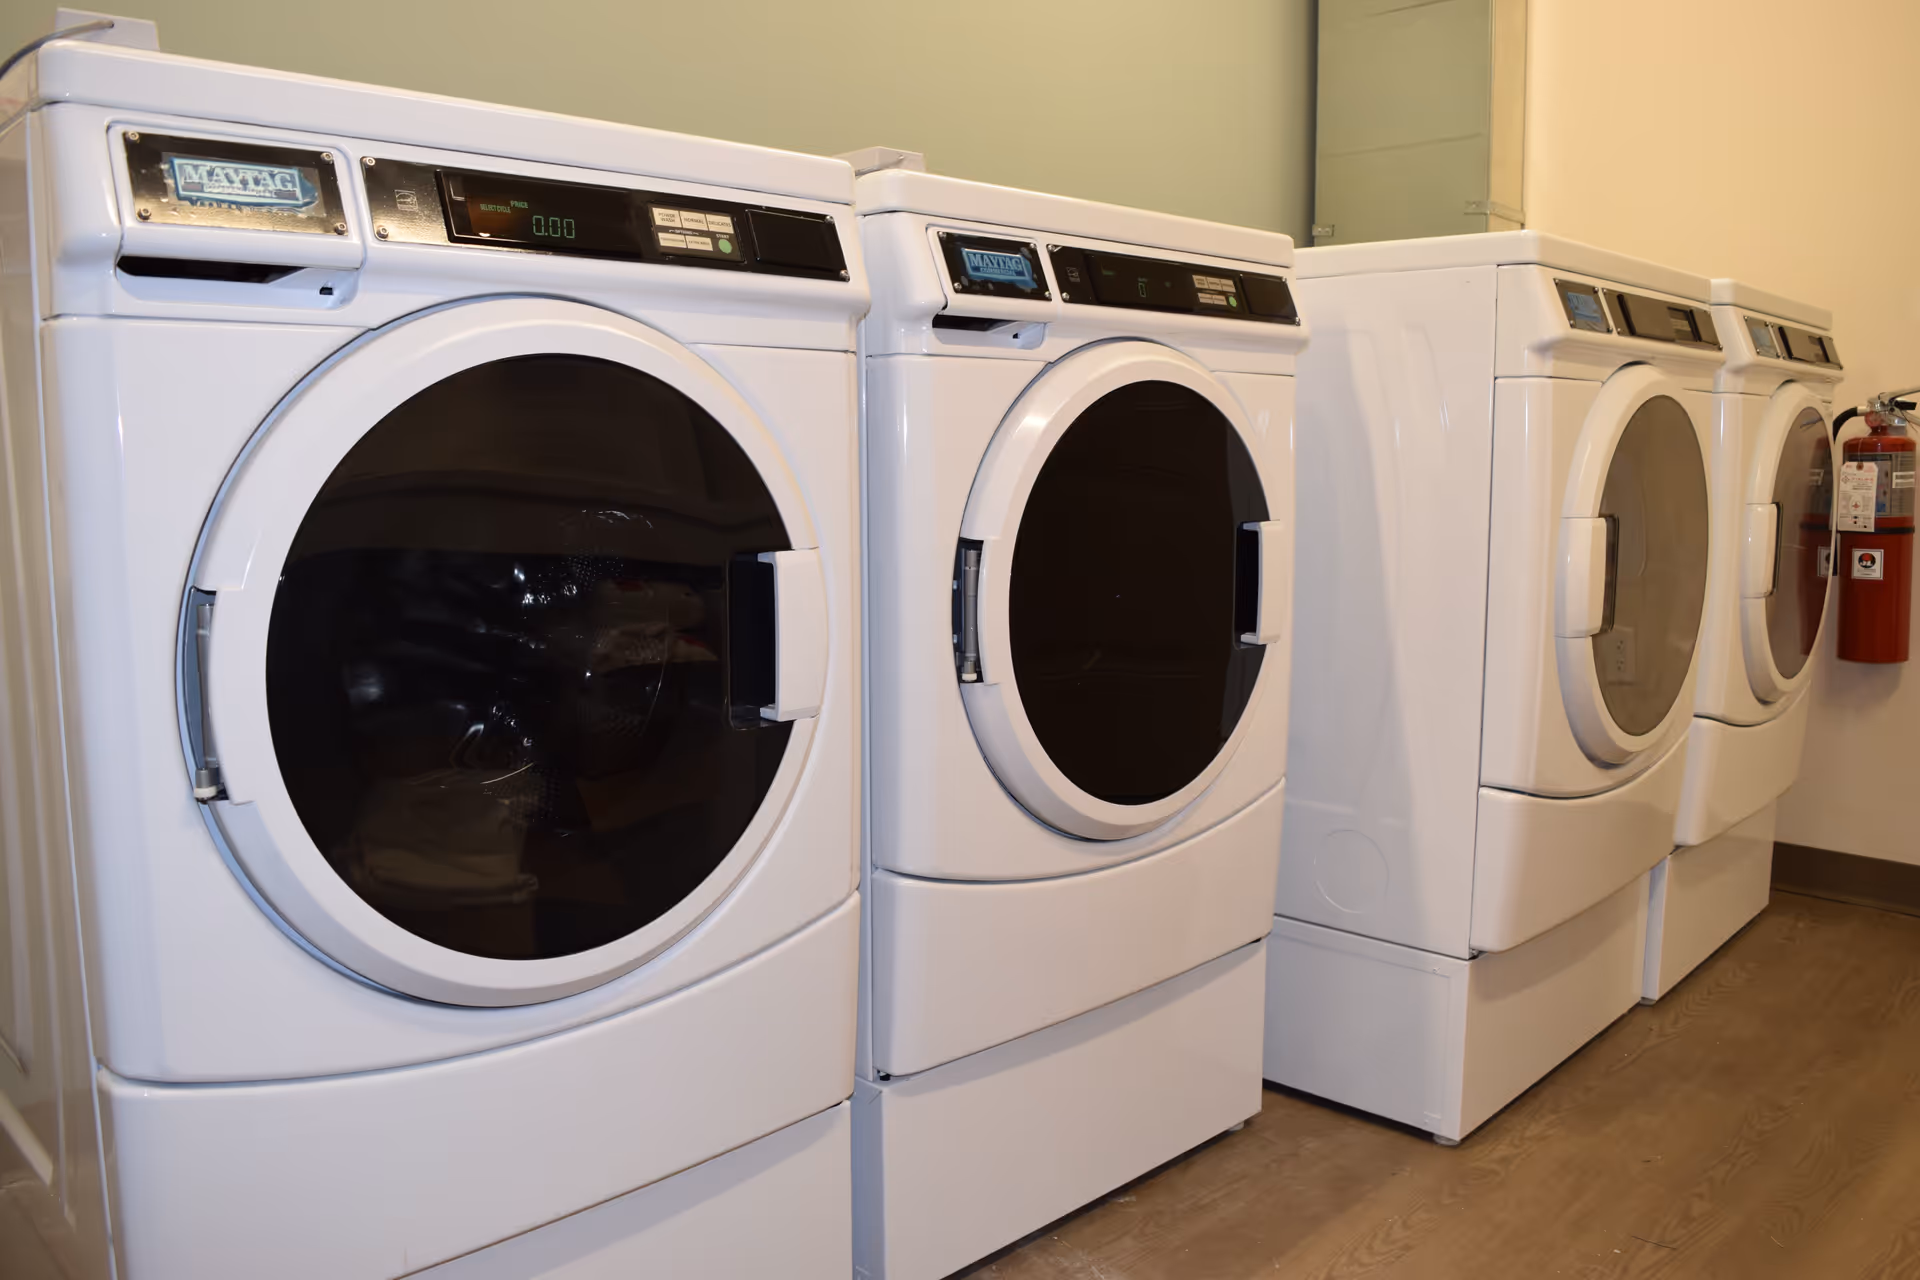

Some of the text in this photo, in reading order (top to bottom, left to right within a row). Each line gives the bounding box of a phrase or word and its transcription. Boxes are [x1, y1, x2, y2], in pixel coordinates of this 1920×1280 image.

[182, 164, 294, 191] MAYTAG
[480, 203, 496, 212] SELECT
[510, 200, 528, 209] PRICE
[532, 215, 575, 239] 0.00
[683, 217, 704, 225] NORMAL
[967, 253, 1023, 271] MAYTAG
